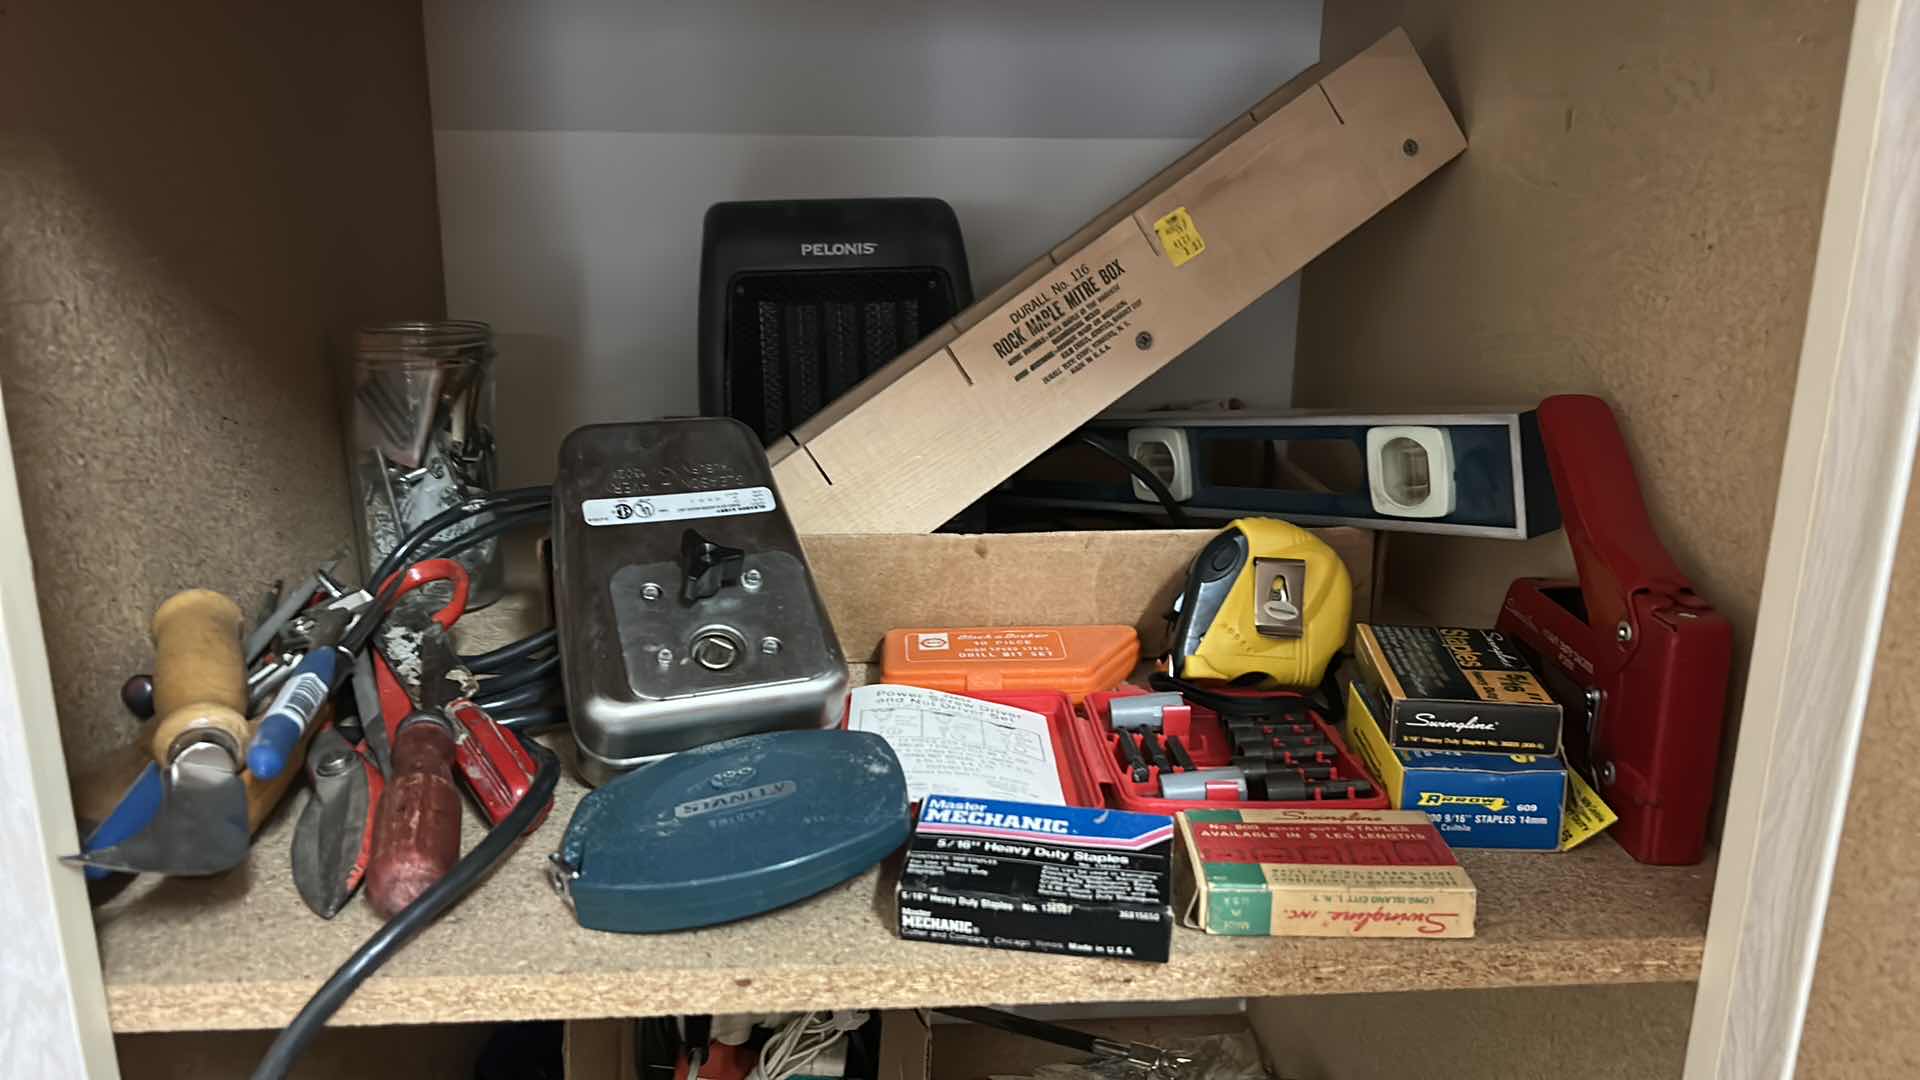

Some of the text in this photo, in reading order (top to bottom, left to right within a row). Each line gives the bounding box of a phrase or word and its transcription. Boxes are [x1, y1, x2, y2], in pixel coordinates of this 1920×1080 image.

[801, 242, 877, 256] PELONIS
[1009, 264, 1090, 325] DURALL No. 116
[992, 326, 1027, 358] ROCK
[1026, 300, 1065, 336] MAPLE
[1064, 276, 1100, 310] MITRE
[1098, 258, 1126, 285] BOX
[1440, 628, 1482, 667] Staples
[876, 689, 923, 699] Power
[980, 702, 1023, 720] Driver
[876, 696, 906, 705] and
[909, 697, 936, 708] Nut
[989, 712, 1018, 724] Set
[1406, 713, 1498, 733] Swingline
[683, 782, 786, 814] STANLEY
[928, 799, 987, 812] Master
[1274, 811, 1383, 822] Swingline
[1475, 815, 1516, 824] STAPLES
[1520, 815, 1548, 824] 14mm
[1200, 831, 1279, 839] AVAILABLE
[1325, 832, 1354, 840] LEG
[1358, 833, 1426, 841] LENGTHS
[1346, 824, 1410, 832] STAPLES
[985, 840, 1030, 858] Heavy
[1034, 845, 1069, 863] Duty
[1074, 848, 1129, 866] Staples
[929, 894, 957, 906] Heavy
[958, 897, 978, 908] Duty
[980, 899, 1013, 911] Staples
[902, 908, 931, 917] Master
[1282, 904, 1458, 934] Swingline INC.
[1068, 942, 1093, 953] Made
